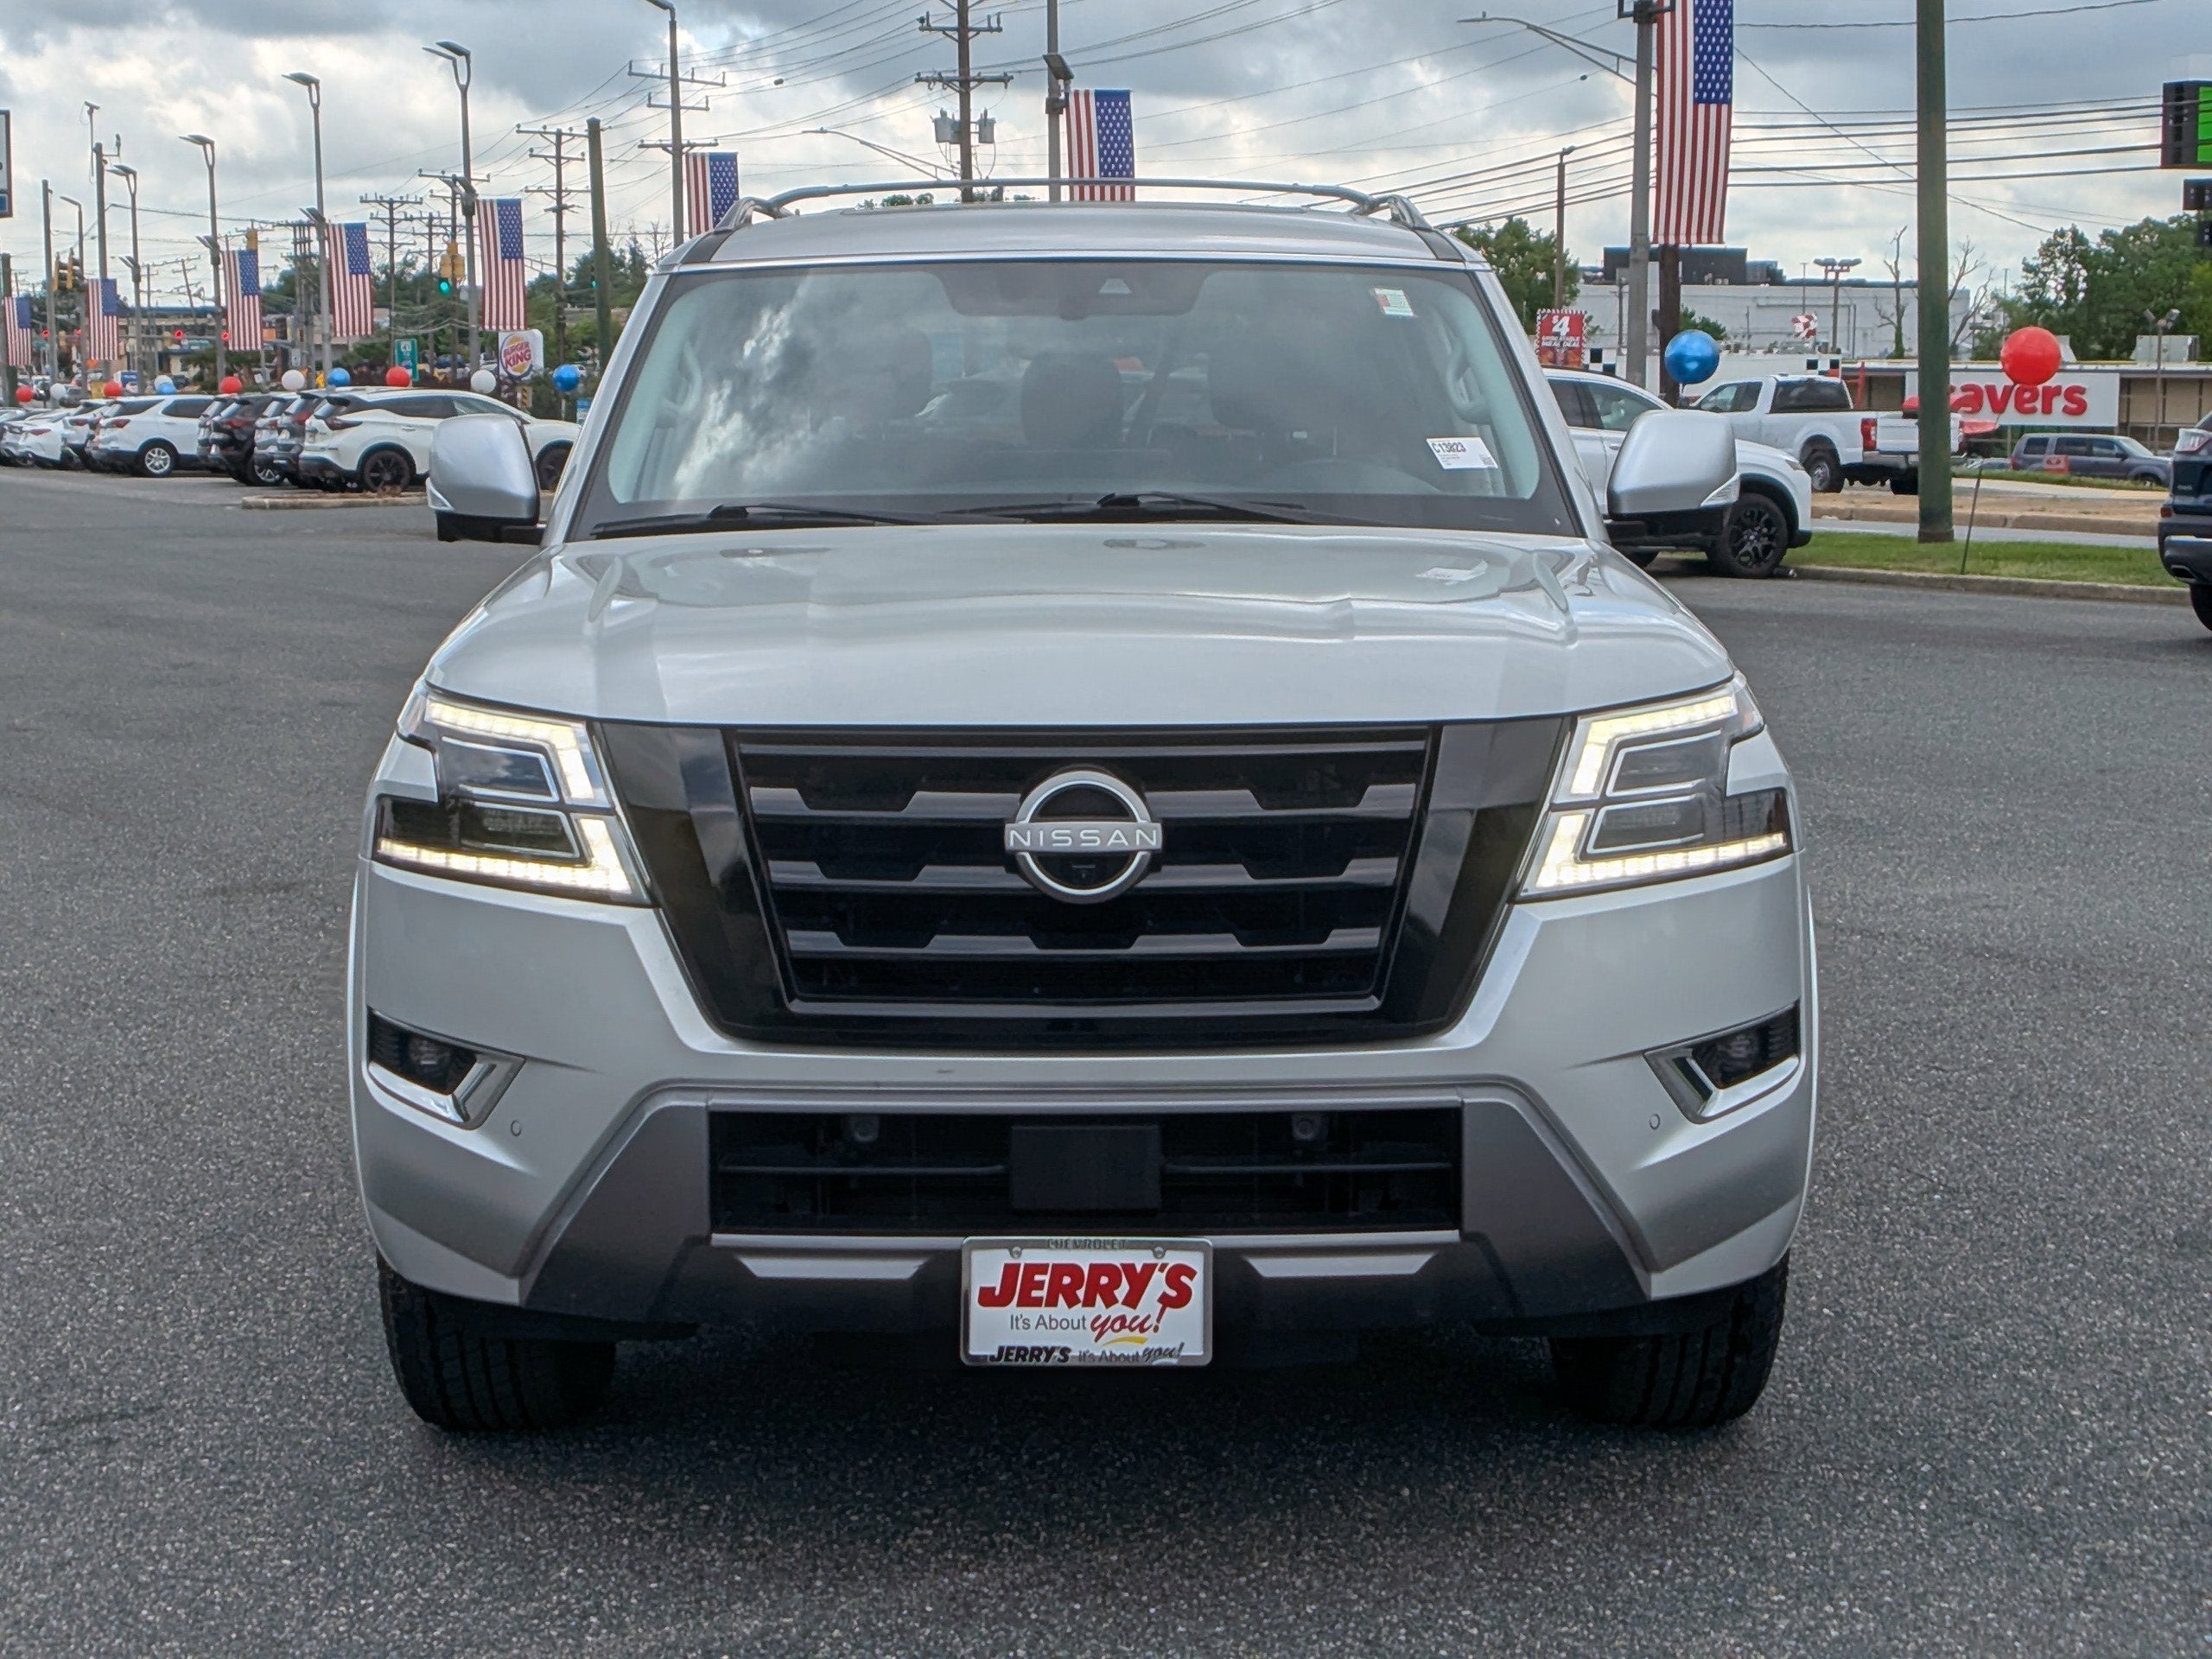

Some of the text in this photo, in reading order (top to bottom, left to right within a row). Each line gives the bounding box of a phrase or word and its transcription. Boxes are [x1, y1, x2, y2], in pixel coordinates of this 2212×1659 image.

[504, 341, 530, 356] BURGER
[505, 349, 531, 369] KING
[1948, 384, 2088, 416] avers
[1009, 830, 1157, 847] NISSAN
[1047, 1239, 1125, 1249] CHEVROLET
[978, 1262, 1198, 1310] JERRY'S
[1010, 1306, 1167, 1343] It's About you!
[989, 1342, 1185, 1363] JERRY'S It's About you!
